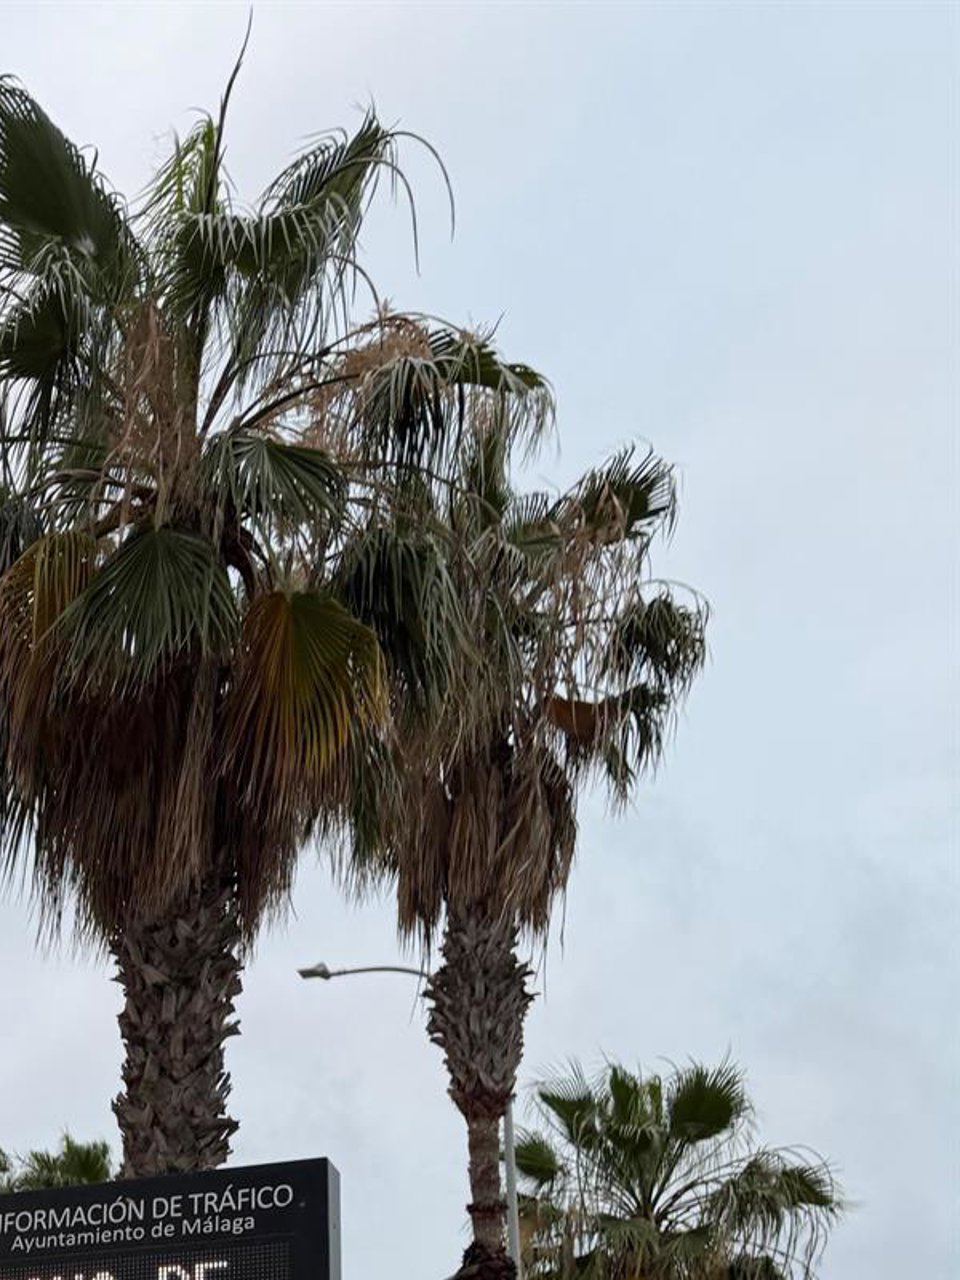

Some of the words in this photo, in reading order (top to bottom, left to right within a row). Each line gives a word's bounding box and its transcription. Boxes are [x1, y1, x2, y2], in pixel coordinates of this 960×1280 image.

[152, 1195, 182, 1219] DE
[189, 1184, 294, 1215] TRÁFICO
[11, 1225, 145, 1252] Ayuntamiento
[151, 1221, 175, 1238] de
[182, 1215, 255, 1236] Málaga
